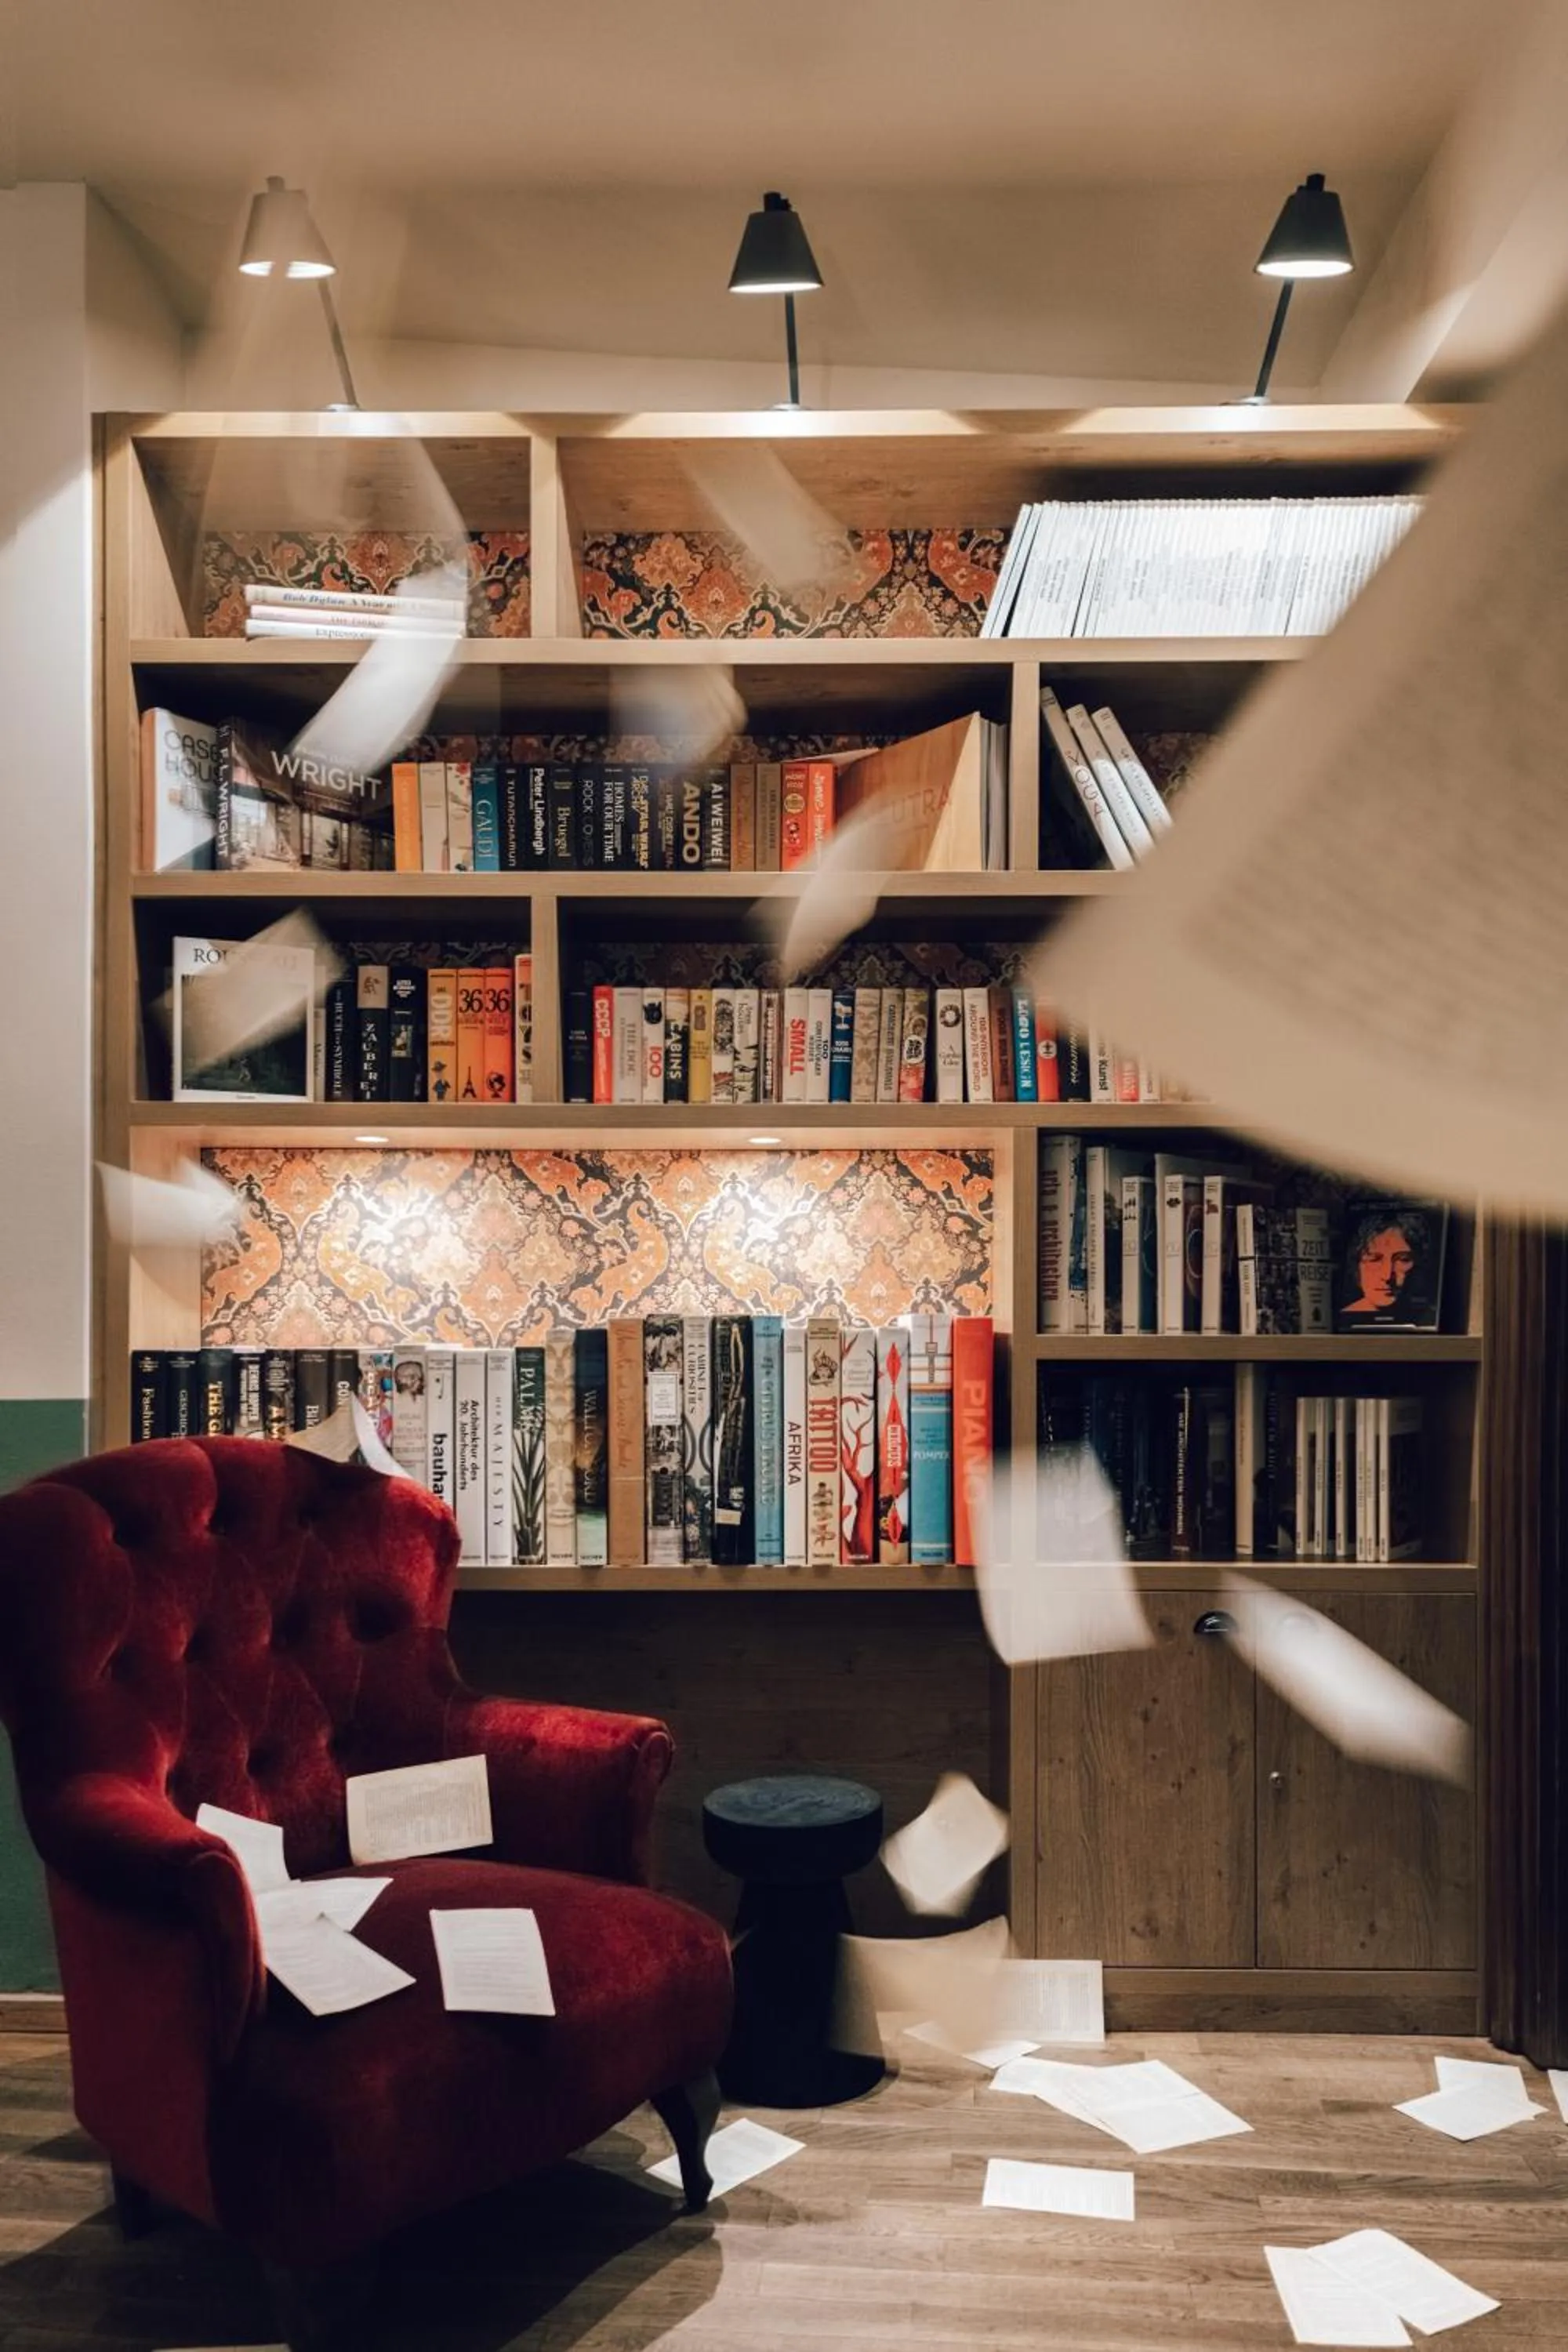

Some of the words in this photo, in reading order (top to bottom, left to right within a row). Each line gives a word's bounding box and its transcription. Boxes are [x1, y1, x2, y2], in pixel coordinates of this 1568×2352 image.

[308, 593, 346, 608] Dylan
[165, 752, 220, 784] HOU
[270, 750, 382, 800] WRIGHT
[533, 768, 545, 798] Peter
[711, 782, 724, 798] AI
[1064, 750, 1104, 818] YOGA
[583, 779, 593, 814] ROCK
[603, 782, 614, 804] FOR
[615, 781, 625, 822] HOMES
[532, 800, 546, 855] Lindbergh
[603, 806, 614, 830] OUR
[683, 782, 700, 863] ANDO
[711, 804, 724, 862] WEIWEI
[603, 833, 614, 863] TIME
[430, 993, 453, 1038] DDR
[459, 989, 483, 1013] 36
[485, 989, 510, 1013] 36
[594, 999, 611, 1037] CCCP
[650, 1046, 662, 1078] 100
[670, 1022, 682, 1080] CABINS
[789, 1018, 806, 1076] SMALL
[1098, 1059, 1109, 1091] Kunst
[1299, 1263, 1330, 1283] REISE
[688, 1344, 697, 1414] CURIOSITIES
[698, 1343, 707, 1391] CABINET
[142, 1388, 155, 1439] Fashion
[470, 1400, 481, 1458] Architektur
[808, 1396, 837, 1473] TATTOO
[459, 1421, 469, 1491] Jahrhunderts
[787, 1421, 802, 1486] AFRIKA
[962, 1379, 988, 1505] PIANO
[432, 1433, 448, 1500] bauha
[470, 1462, 481, 1481] des
[492, 1423, 504, 1527] MAJESTY
